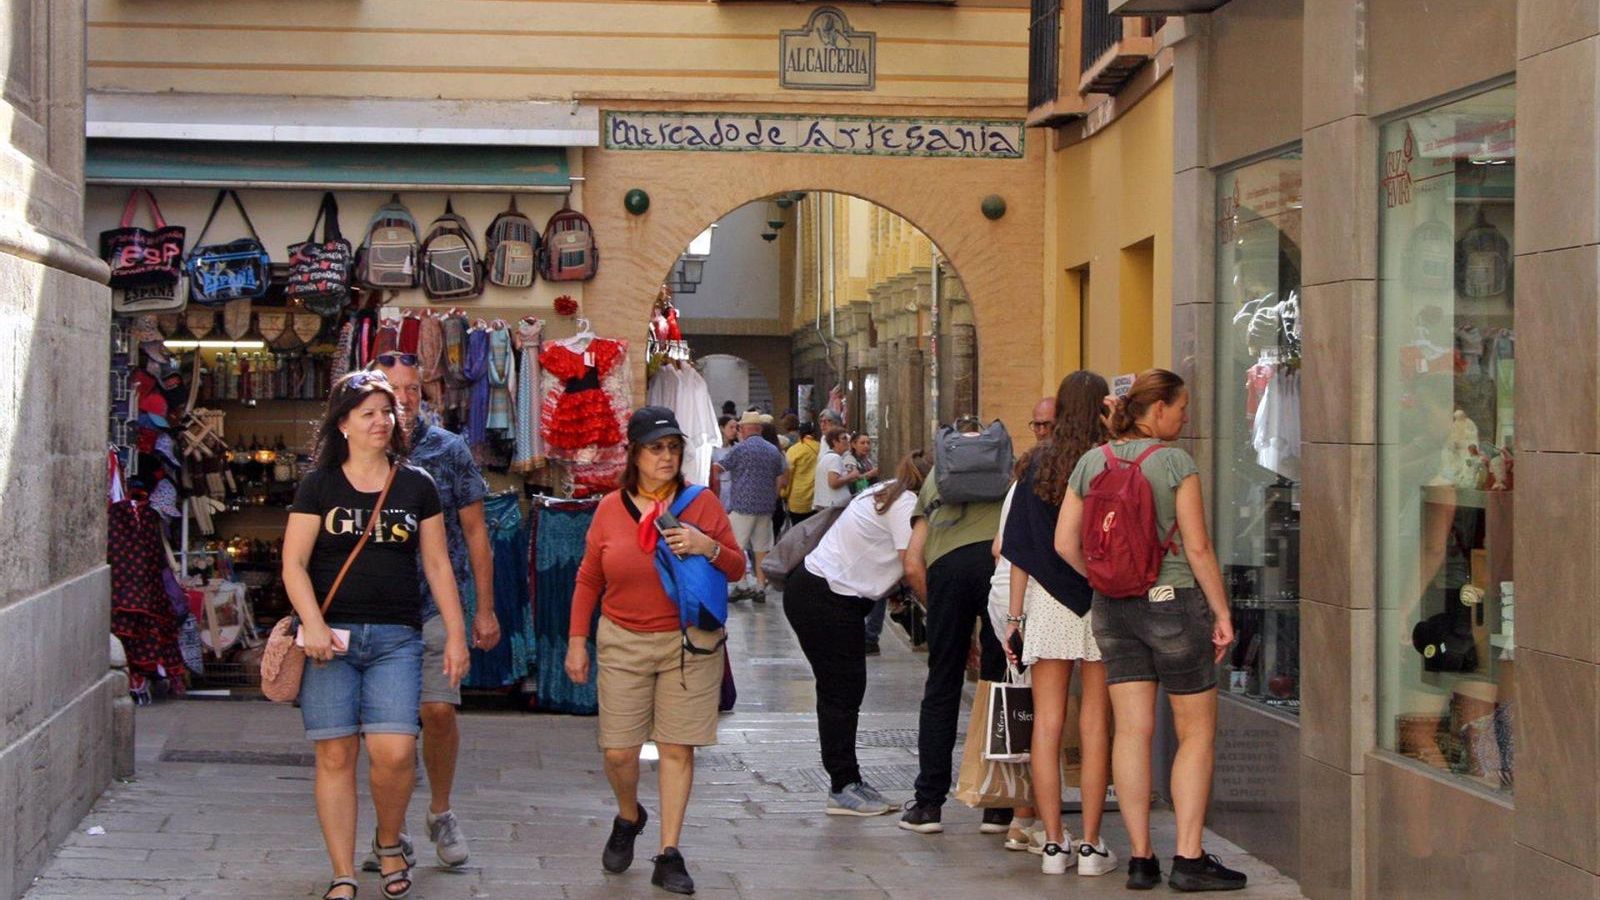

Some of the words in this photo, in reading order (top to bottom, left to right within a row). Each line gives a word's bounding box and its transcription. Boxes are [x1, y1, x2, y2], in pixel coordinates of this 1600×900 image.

[786, 47, 868, 74] ALCAICERIA
[612, 115, 740, 146] Mercado
[745, 119, 786, 146] de
[799, 121, 1018, 154] Artesania
